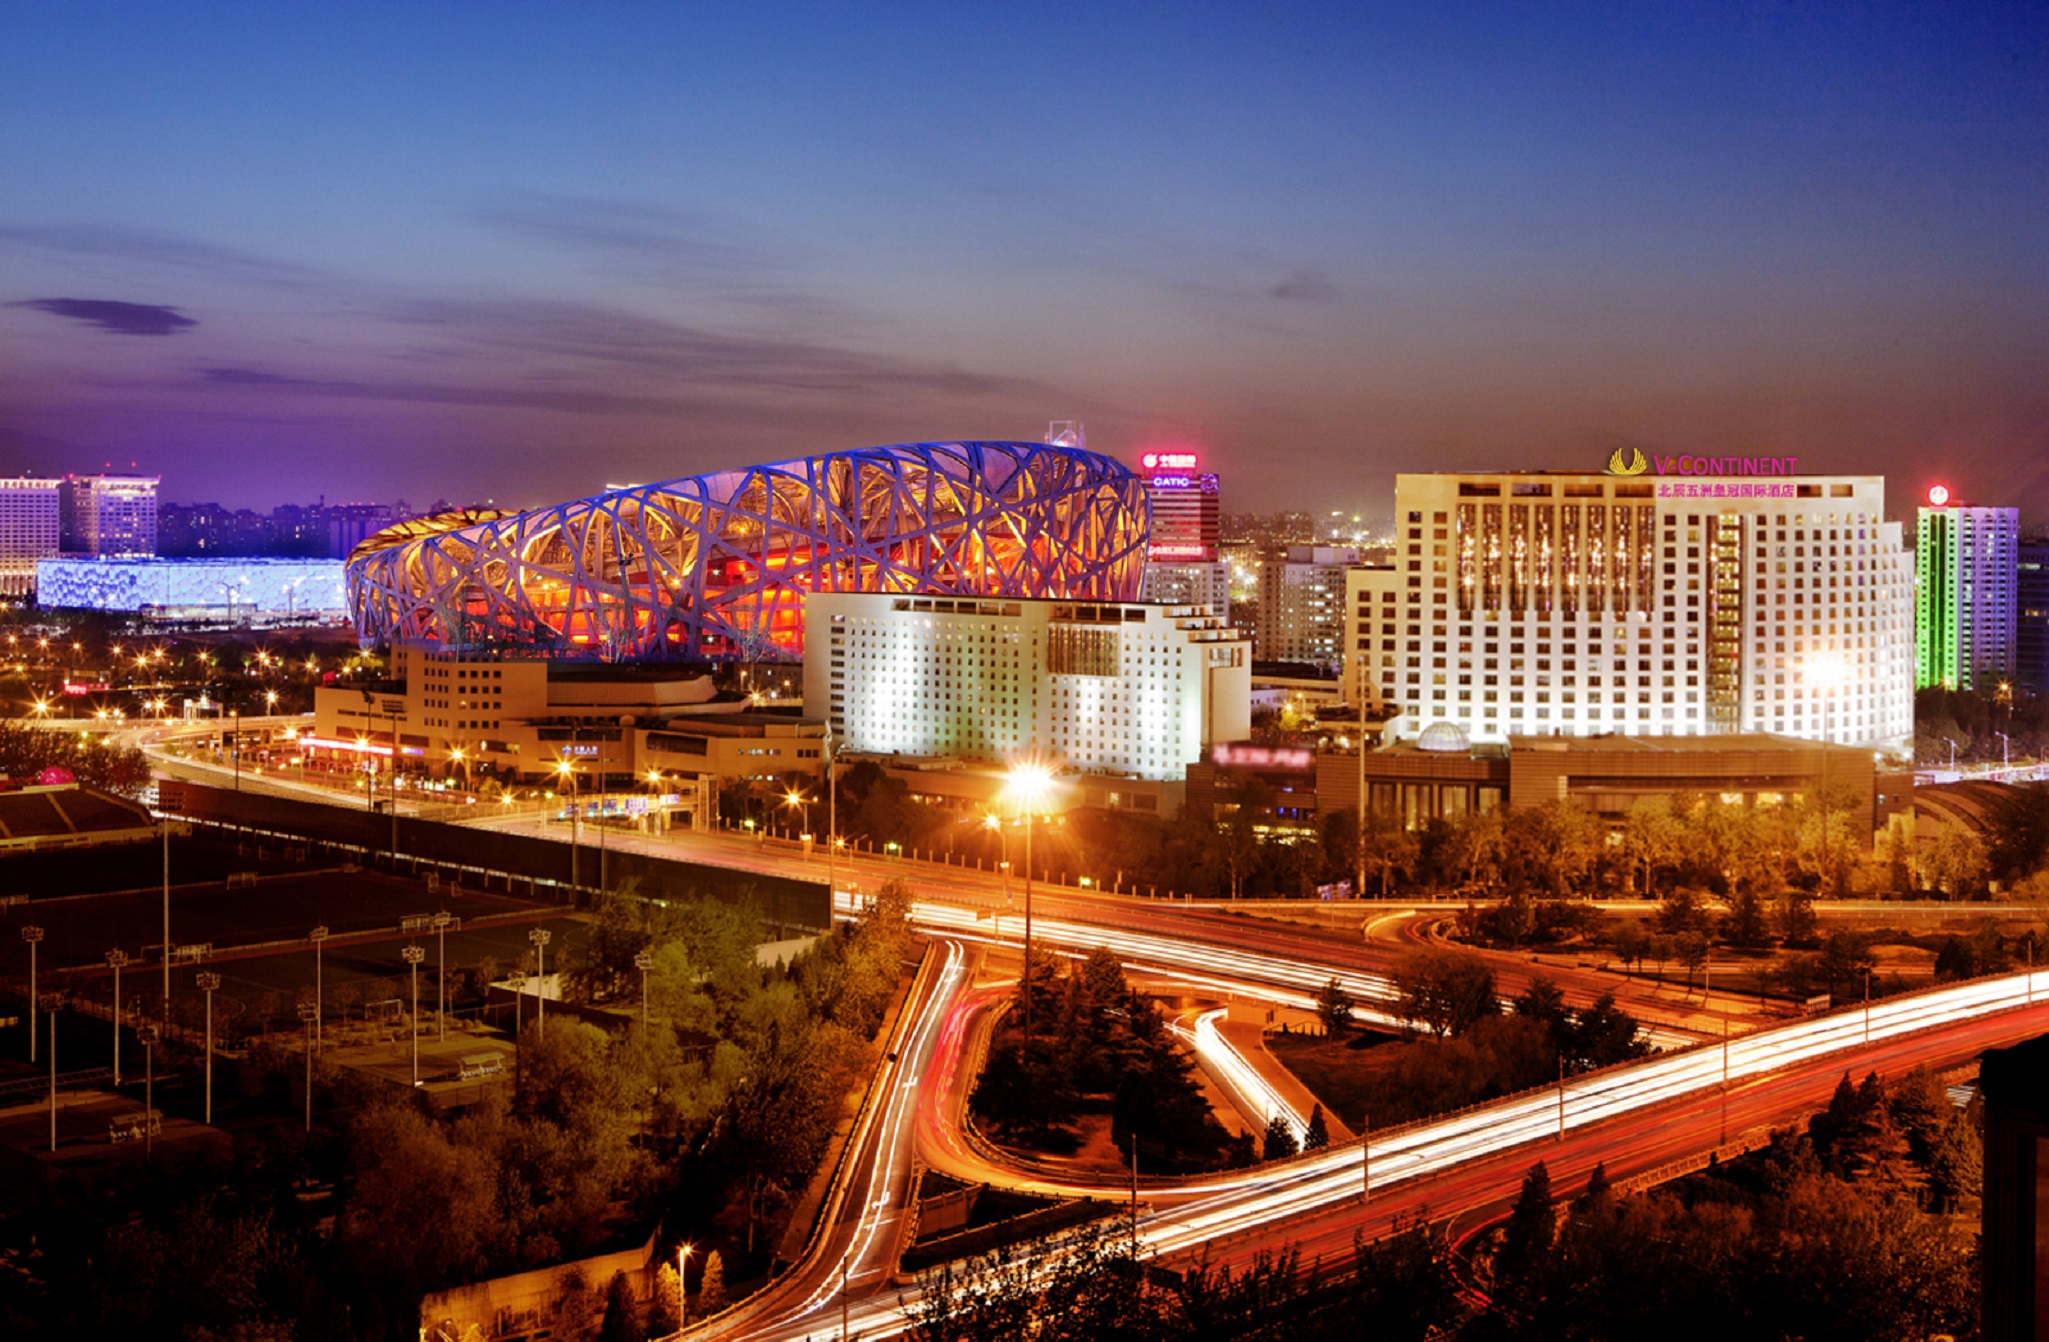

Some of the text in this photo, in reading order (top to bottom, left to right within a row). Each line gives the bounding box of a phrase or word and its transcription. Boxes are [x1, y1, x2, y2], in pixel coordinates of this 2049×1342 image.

[1153, 477, 1189, 488] CATIC
[1658, 484, 1795, 498] 北辰五洲皇冠国际酒店
